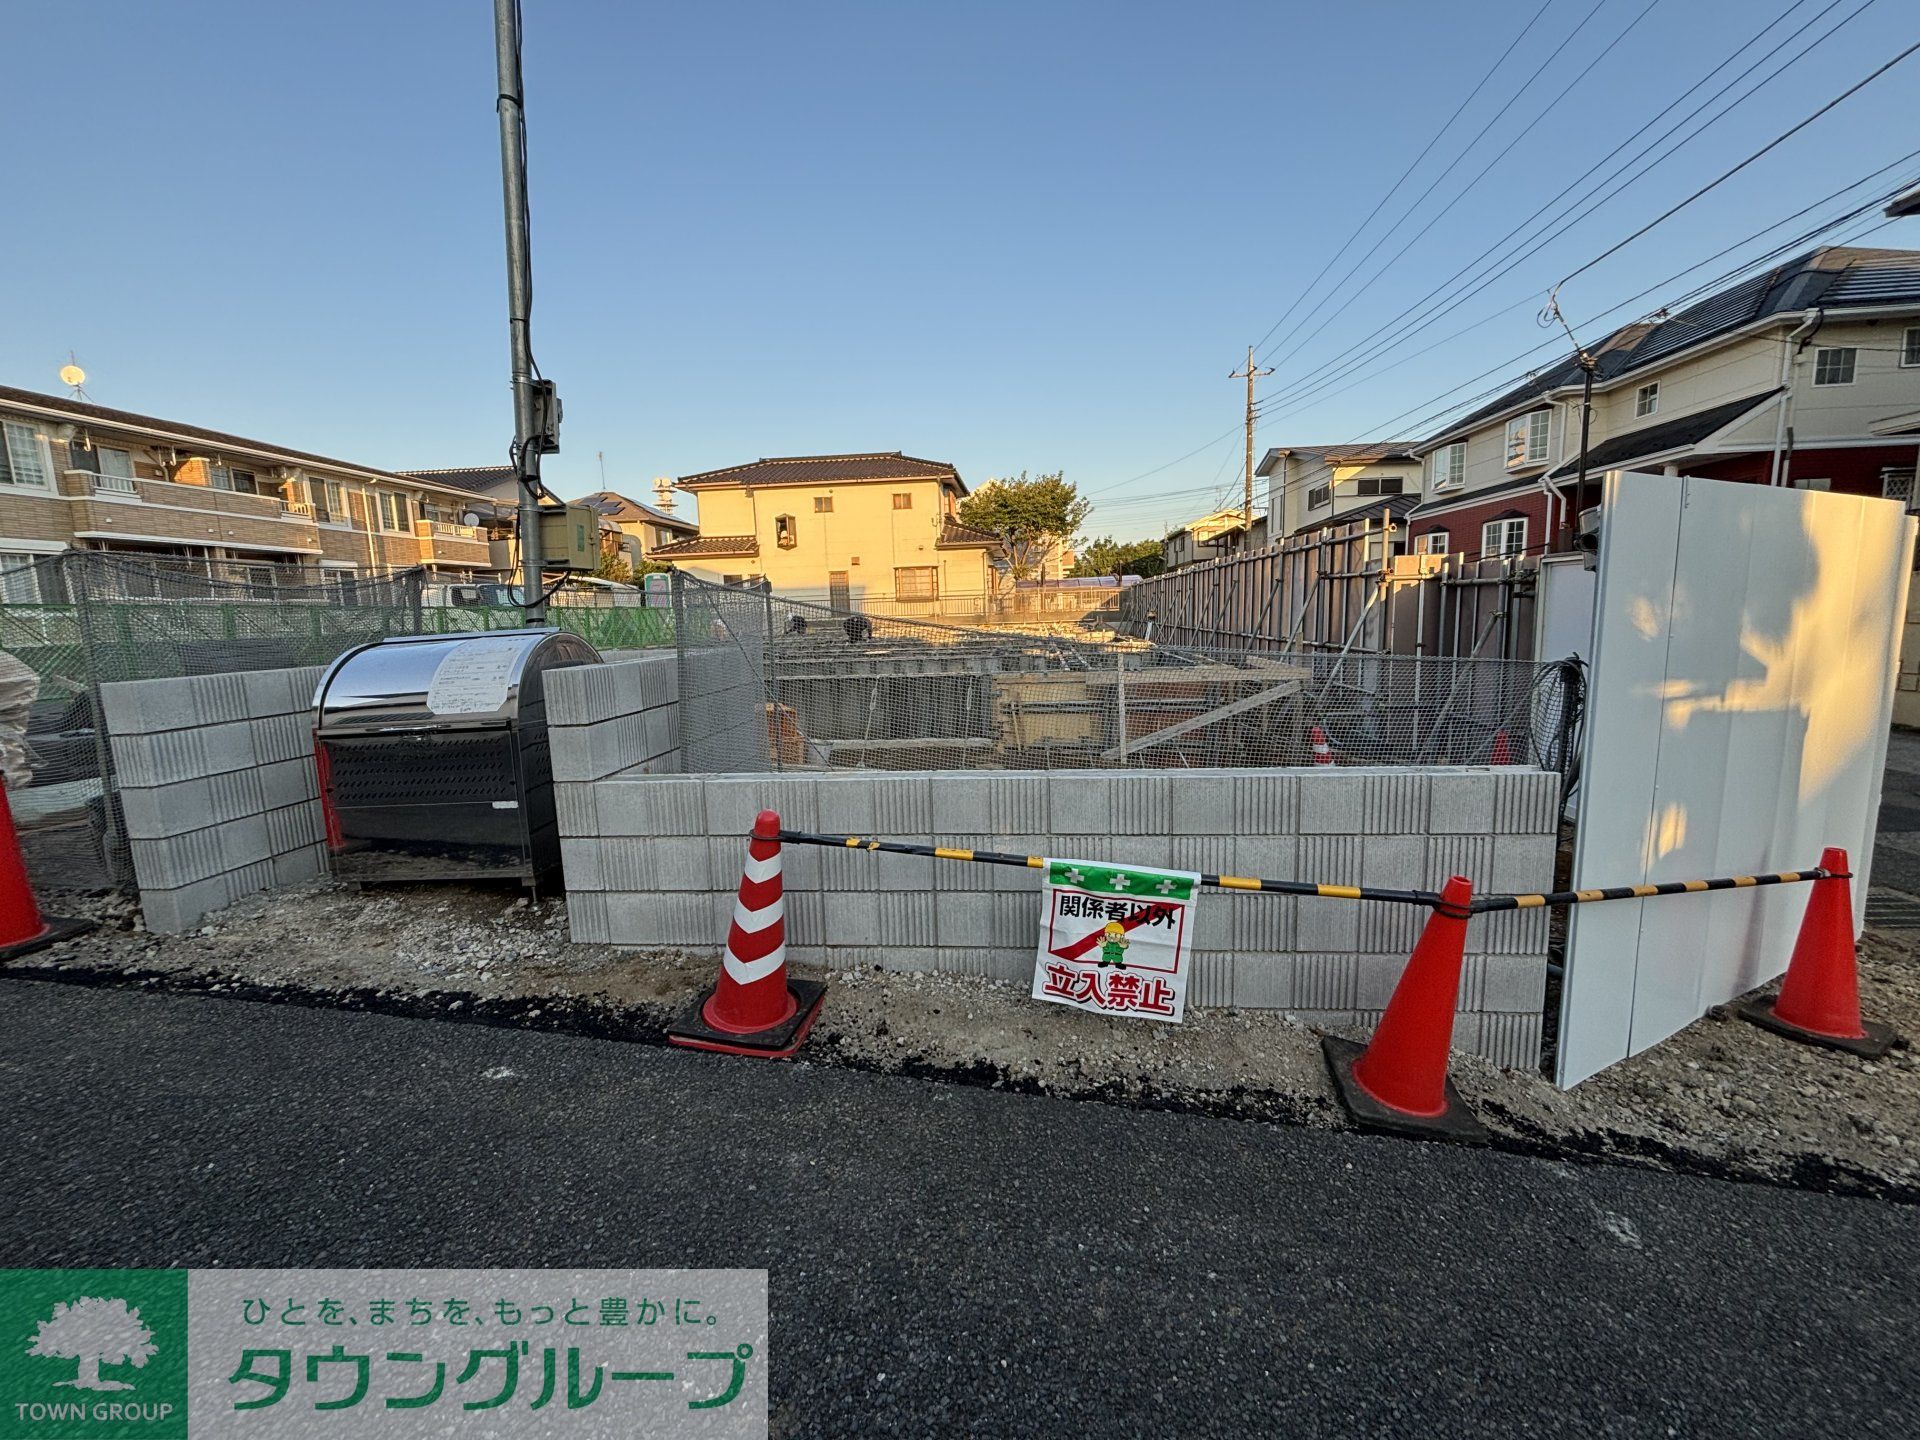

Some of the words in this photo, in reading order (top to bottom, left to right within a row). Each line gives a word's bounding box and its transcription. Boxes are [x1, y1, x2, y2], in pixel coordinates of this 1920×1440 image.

[1059, 895, 1176, 930] 関係者以外
[1043, 963, 1174, 1014] 立入禁止
